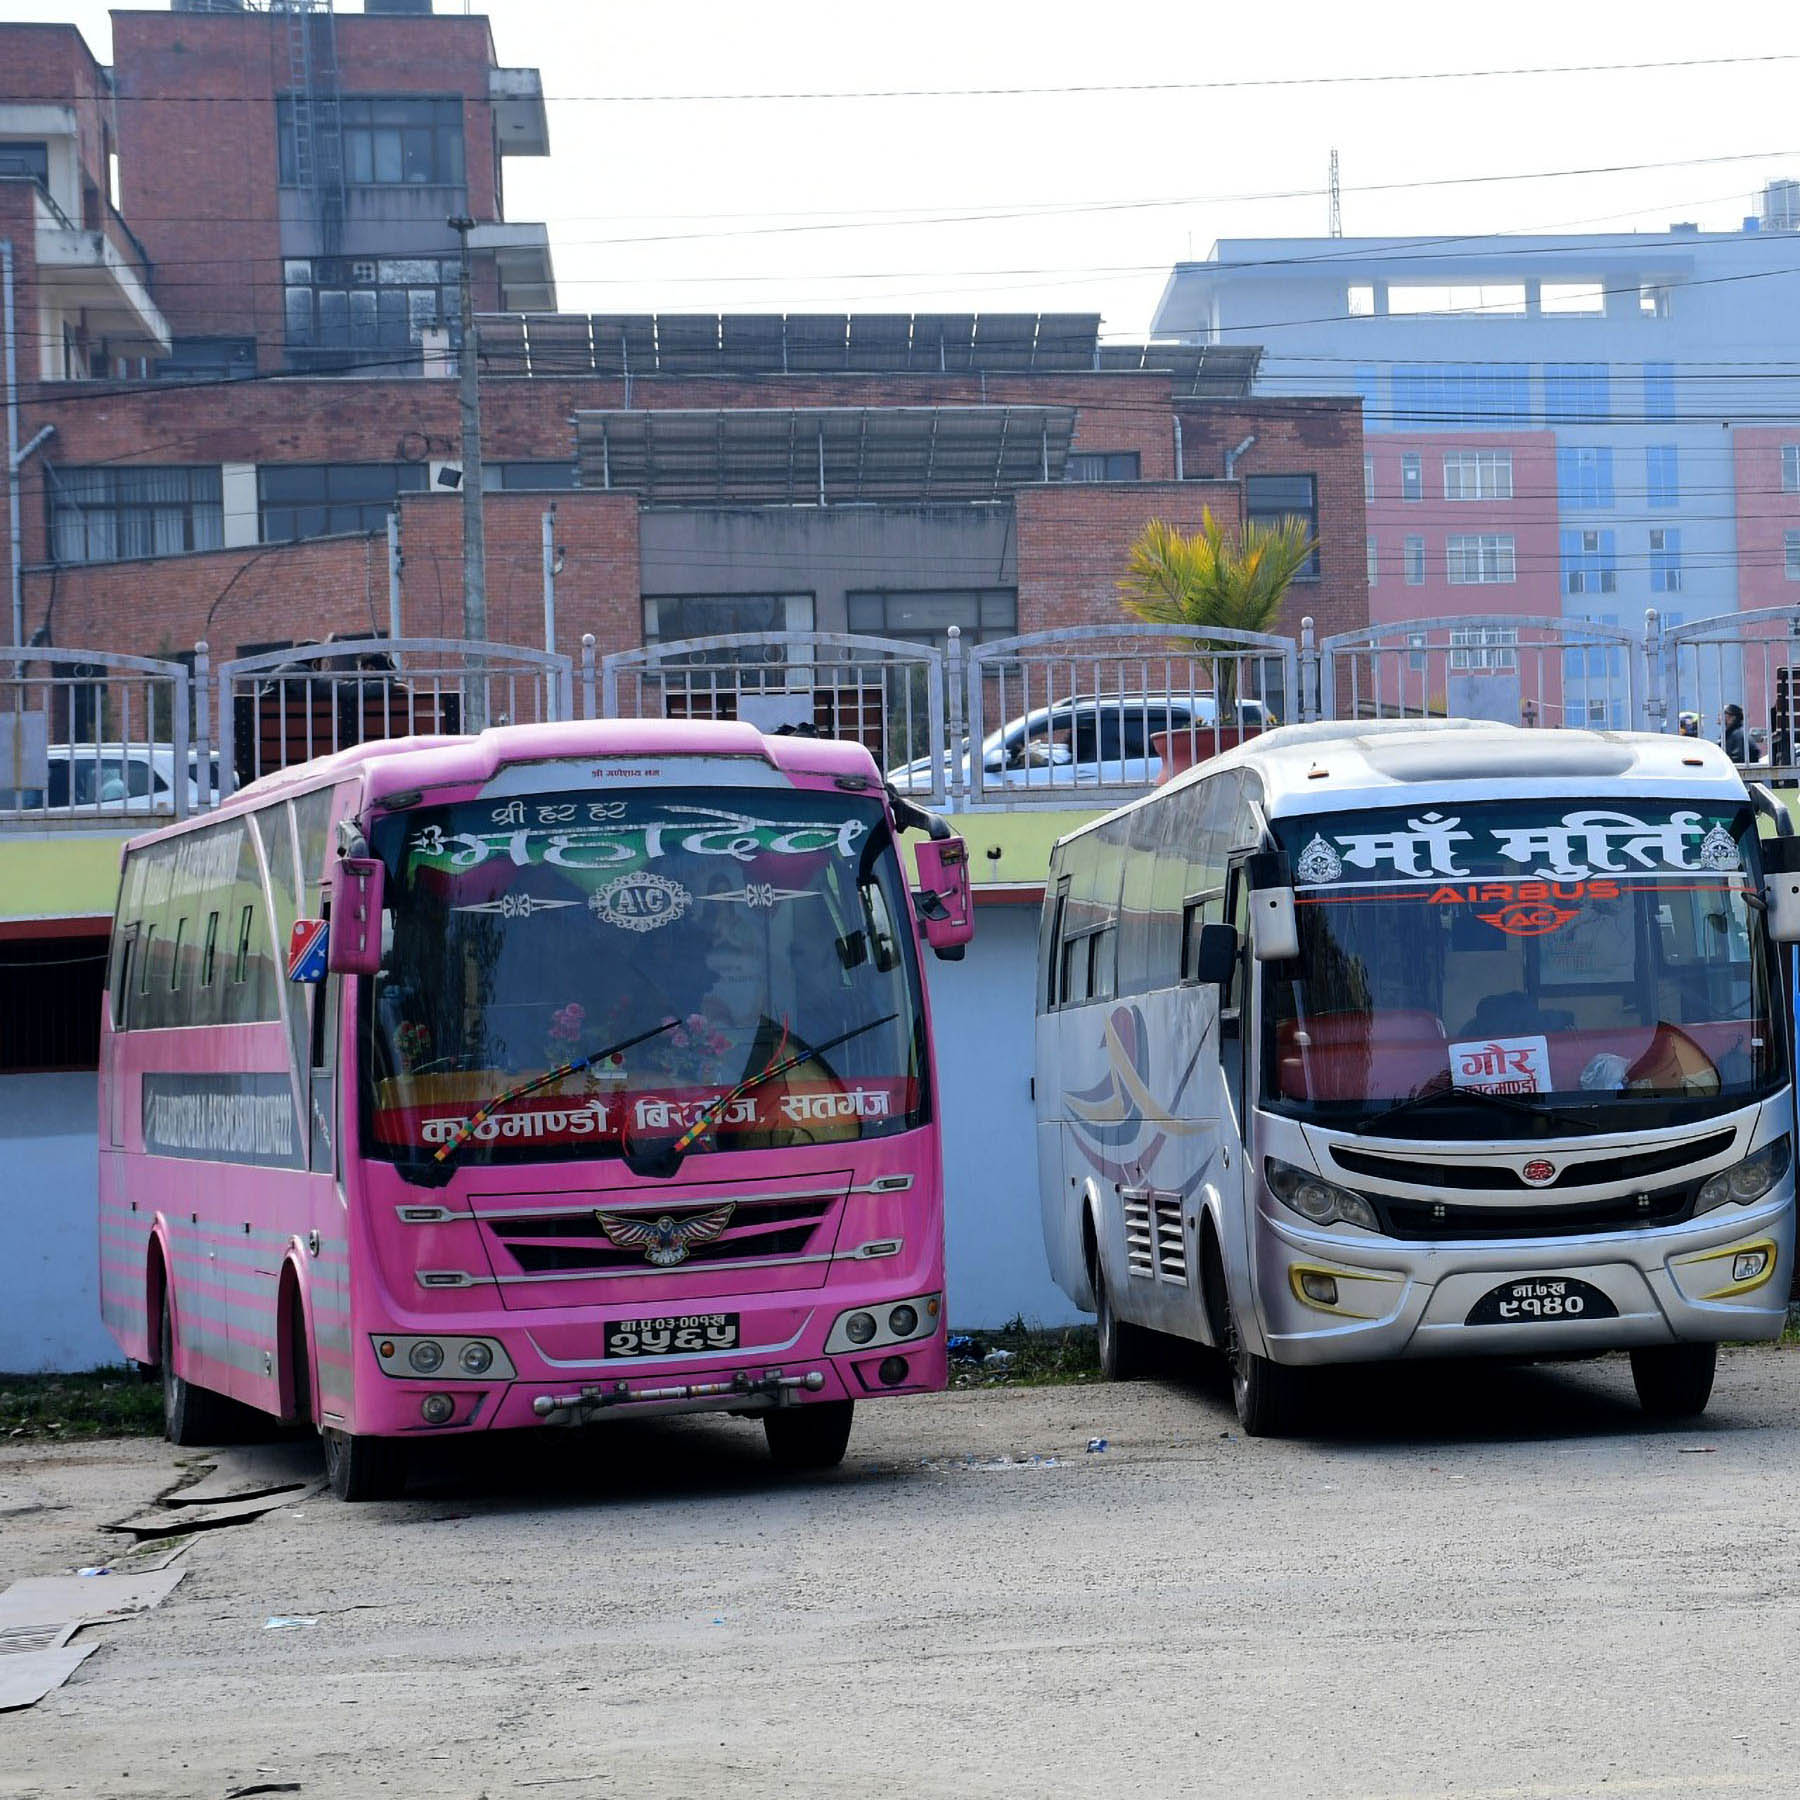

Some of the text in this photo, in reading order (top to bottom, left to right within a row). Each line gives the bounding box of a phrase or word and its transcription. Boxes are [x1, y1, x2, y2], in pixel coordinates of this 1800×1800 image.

[490, 800, 629, 826] श्री हर हर
[1335, 811, 1474, 877] माँ
[1428, 880, 1620, 904] AIRBUS
[1506, 911, 1552, 928] AC
[1459, 1043, 1537, 1079] गौर
[780, 1086, 890, 1122] सतगंज
[609, 1325, 737, 1356] २५६५
